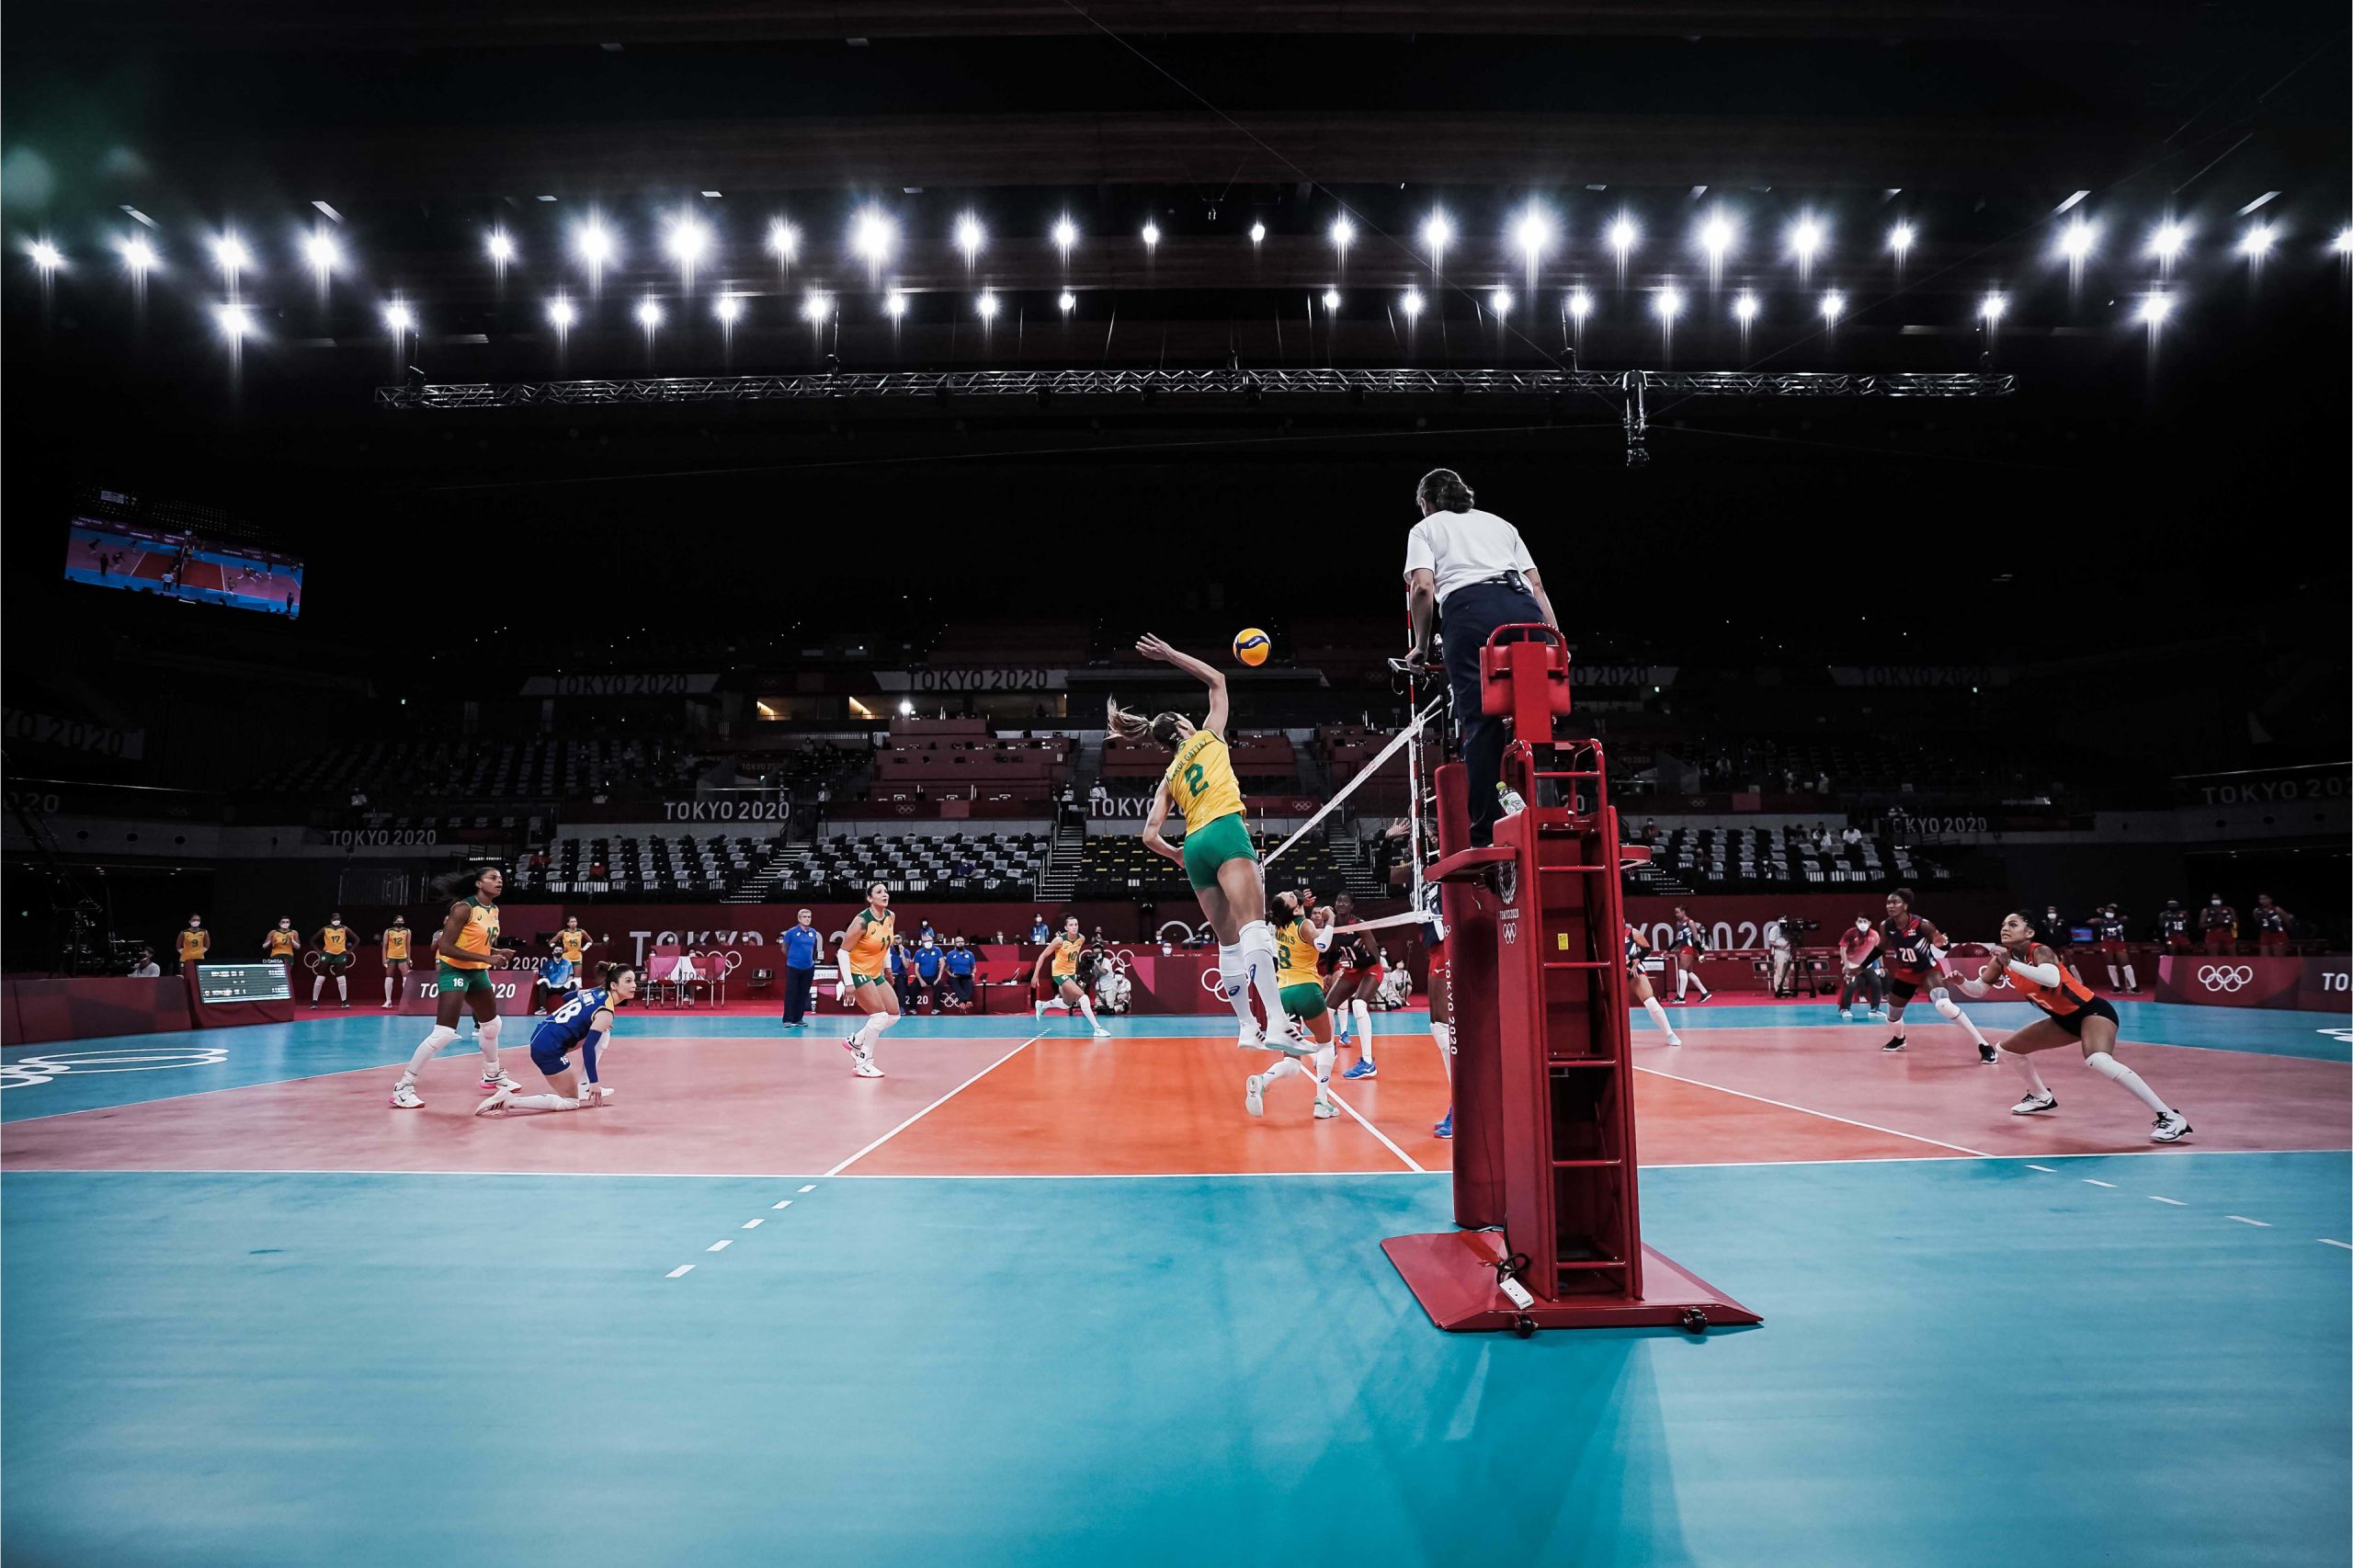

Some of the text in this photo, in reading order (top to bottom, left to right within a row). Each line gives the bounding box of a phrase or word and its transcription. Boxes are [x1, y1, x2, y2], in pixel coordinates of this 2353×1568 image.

[908, 670, 1048, 690] TOKYO 2020
[1594, 667, 1648, 685] 2020
[1861, 667, 1929, 686] TOKYO
[554, 675, 688, 695] TOKYO 2020
[1185, 763, 1210, 798] 2
[2200, 780, 2298, 805] TOKYO
[664, 801, 790, 820] TOKYO 2020
[1944, 816, 1987, 833] 2020
[331, 829, 437, 846] TOKYO 2020
[331, 935, 341, 943] 17
[393, 937, 403, 947] 12
[1067, 951, 1078, 962] 10
[1899, 948, 1918, 962] 20
[453, 977, 463, 987] 16
[905, 995, 929, 1005] 220
[1445, 959, 1458, 1055] TOKYO 2020
